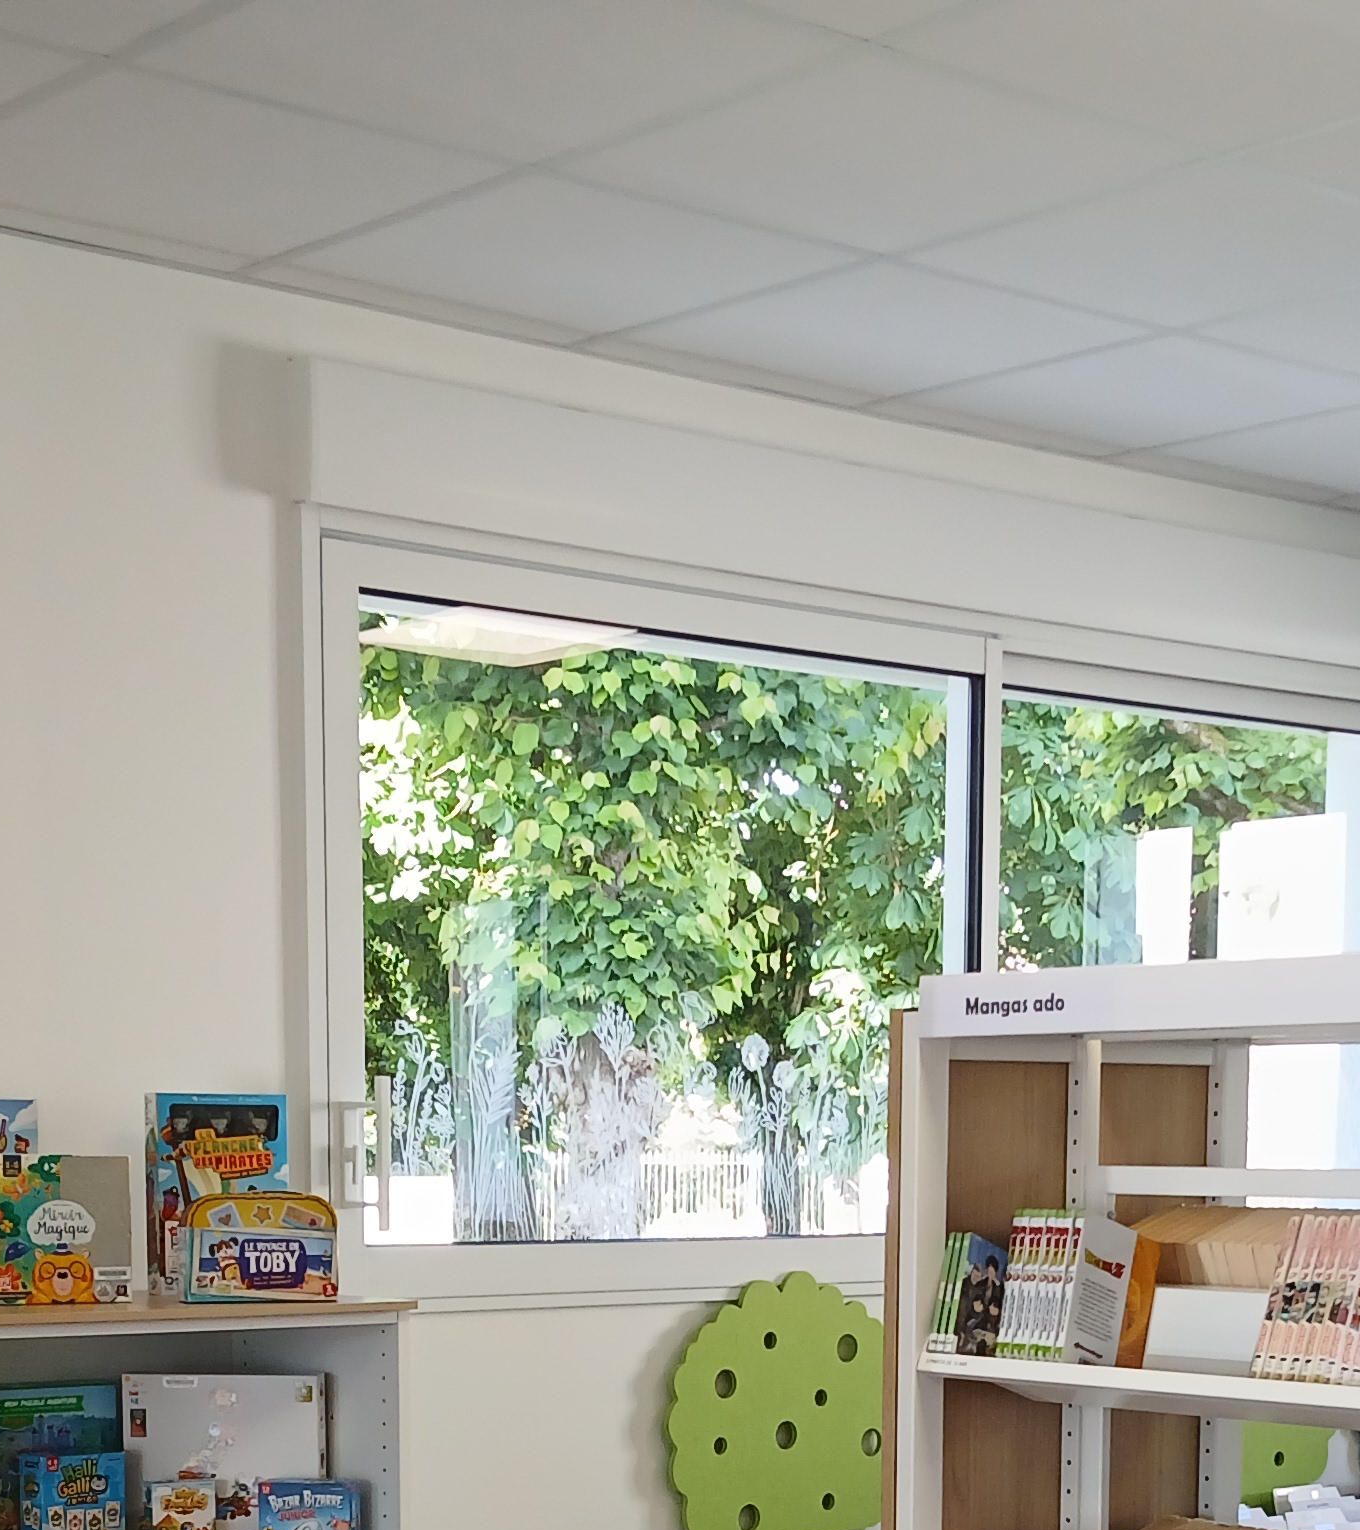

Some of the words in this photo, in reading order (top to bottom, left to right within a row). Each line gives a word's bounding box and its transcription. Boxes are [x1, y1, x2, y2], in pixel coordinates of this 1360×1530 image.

[965, 994, 1028, 1017] Mangas
[1032, 993, 1065, 1013] ado
[214, 1153, 272, 1171] PIRATES
[34, 1221, 90, 1242] Magique
[244, 1251, 301, 1273] TOBY
[62, 1459, 97, 1482] Halli
[57, 1476, 90, 1497] Galli
[302, 1490, 344, 1509] BIZARRE
